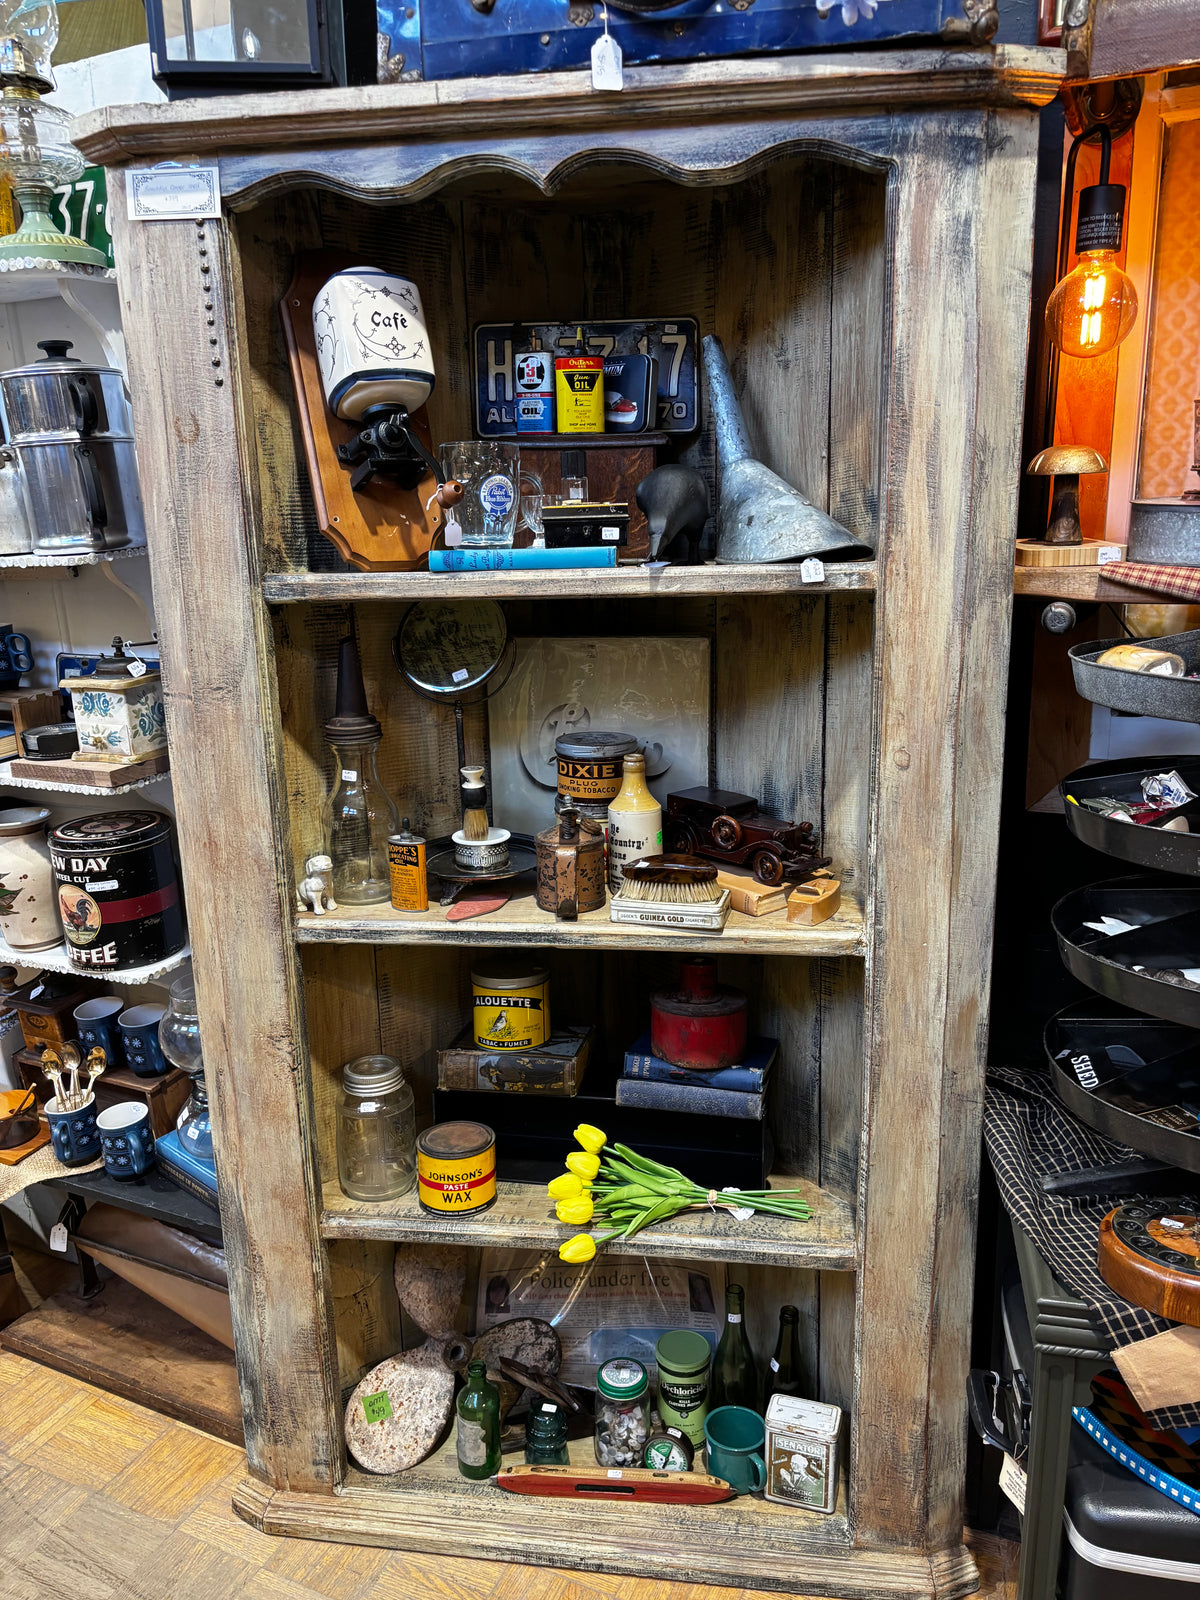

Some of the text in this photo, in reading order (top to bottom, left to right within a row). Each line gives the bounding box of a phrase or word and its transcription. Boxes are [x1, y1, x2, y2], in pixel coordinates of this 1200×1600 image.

[371, 310, 408, 331] Café
[573, 381, 590, 390] OIL
[521, 406, 541, 416] OIL
[658, 400, 688, 420] 70
[558, 761, 615, 778] DIXIE
[558, 783, 581, 793] SMOKING
[569, 779, 598, 787] PLUG
[50, 854, 112, 874] EW DAY
[55, 873, 91, 884] STEEL CUT
[639, 913, 666, 922] GUINEA
[667, 915, 685, 923] GOLD
[66, 940, 118, 966] OFFEE
[475, 996, 532, 1007] ALOUETTE
[480, 1037, 498, 1047] TABAC
[504, 1040, 529, 1048] FUMER
[1070, 1055, 1099, 1088] SHED
[428, 1168, 483, 1182] JOHNSON'S
[443, 1182, 469, 1191] PASTE
[442, 1190, 473, 1204] WAX
[590, 1270, 636, 1288] under
[776, 1437, 822, 1455] SENATOR
